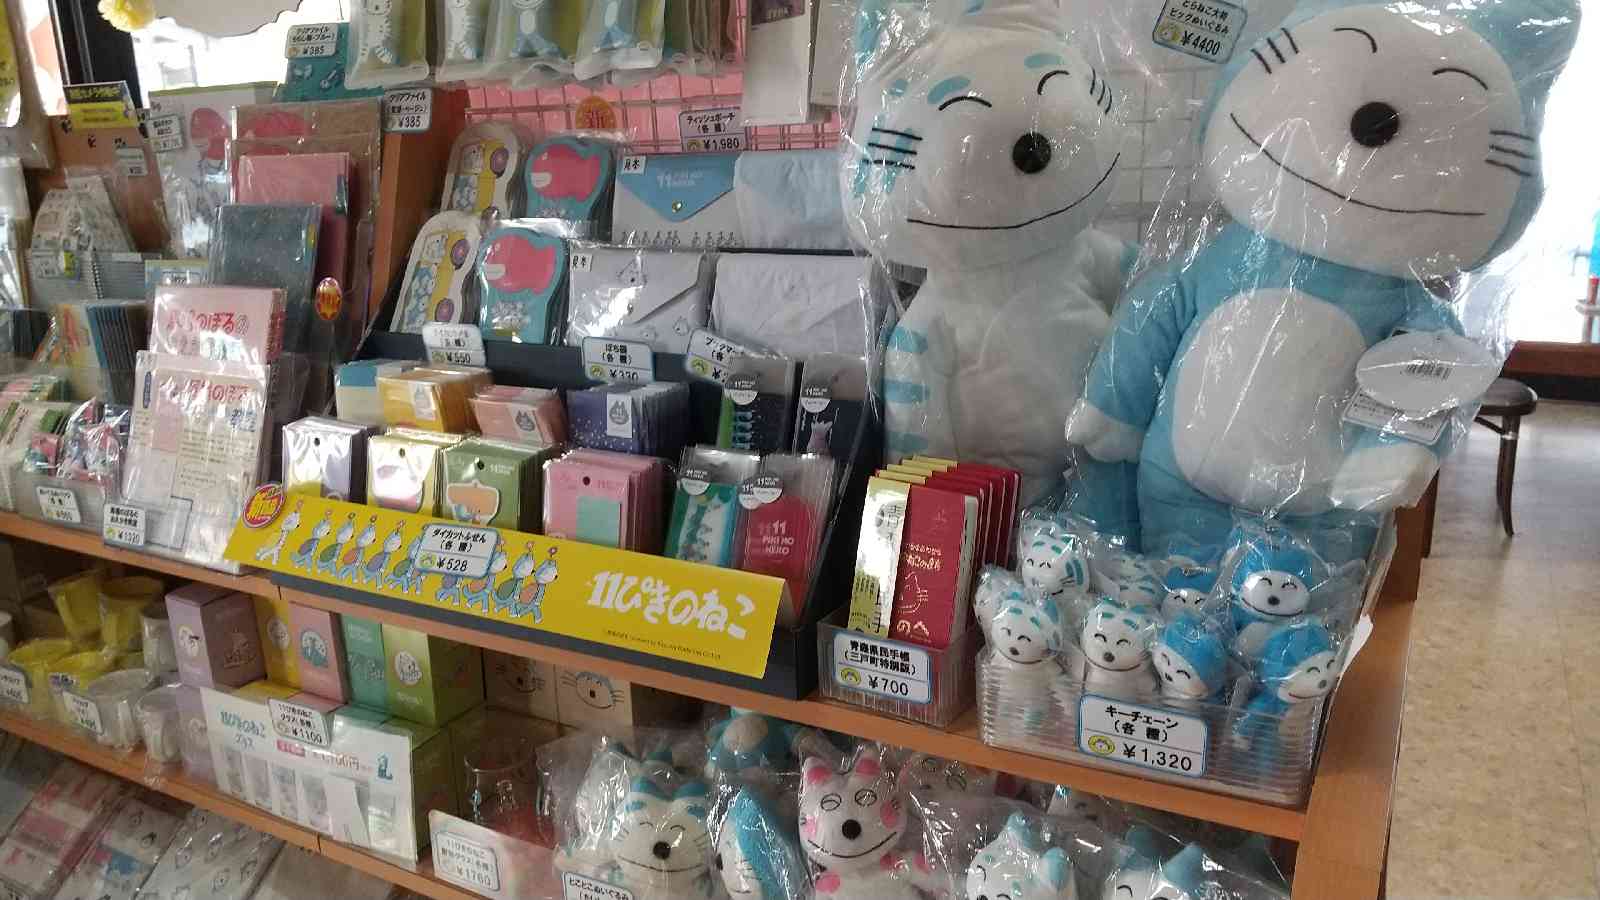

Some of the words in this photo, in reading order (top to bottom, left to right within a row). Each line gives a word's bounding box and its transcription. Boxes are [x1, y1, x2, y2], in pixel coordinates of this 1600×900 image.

[703, 137, 740, 150] ¥1,980
[437, 556, 467, 572] ¥528
[585, 571, 755, 640] 11ぴきのねこ
[867, 674, 909, 696] ¥700
[1105, 705, 1178, 729] キーチェーン
[1123, 743, 1192, 771] ¥1,320
